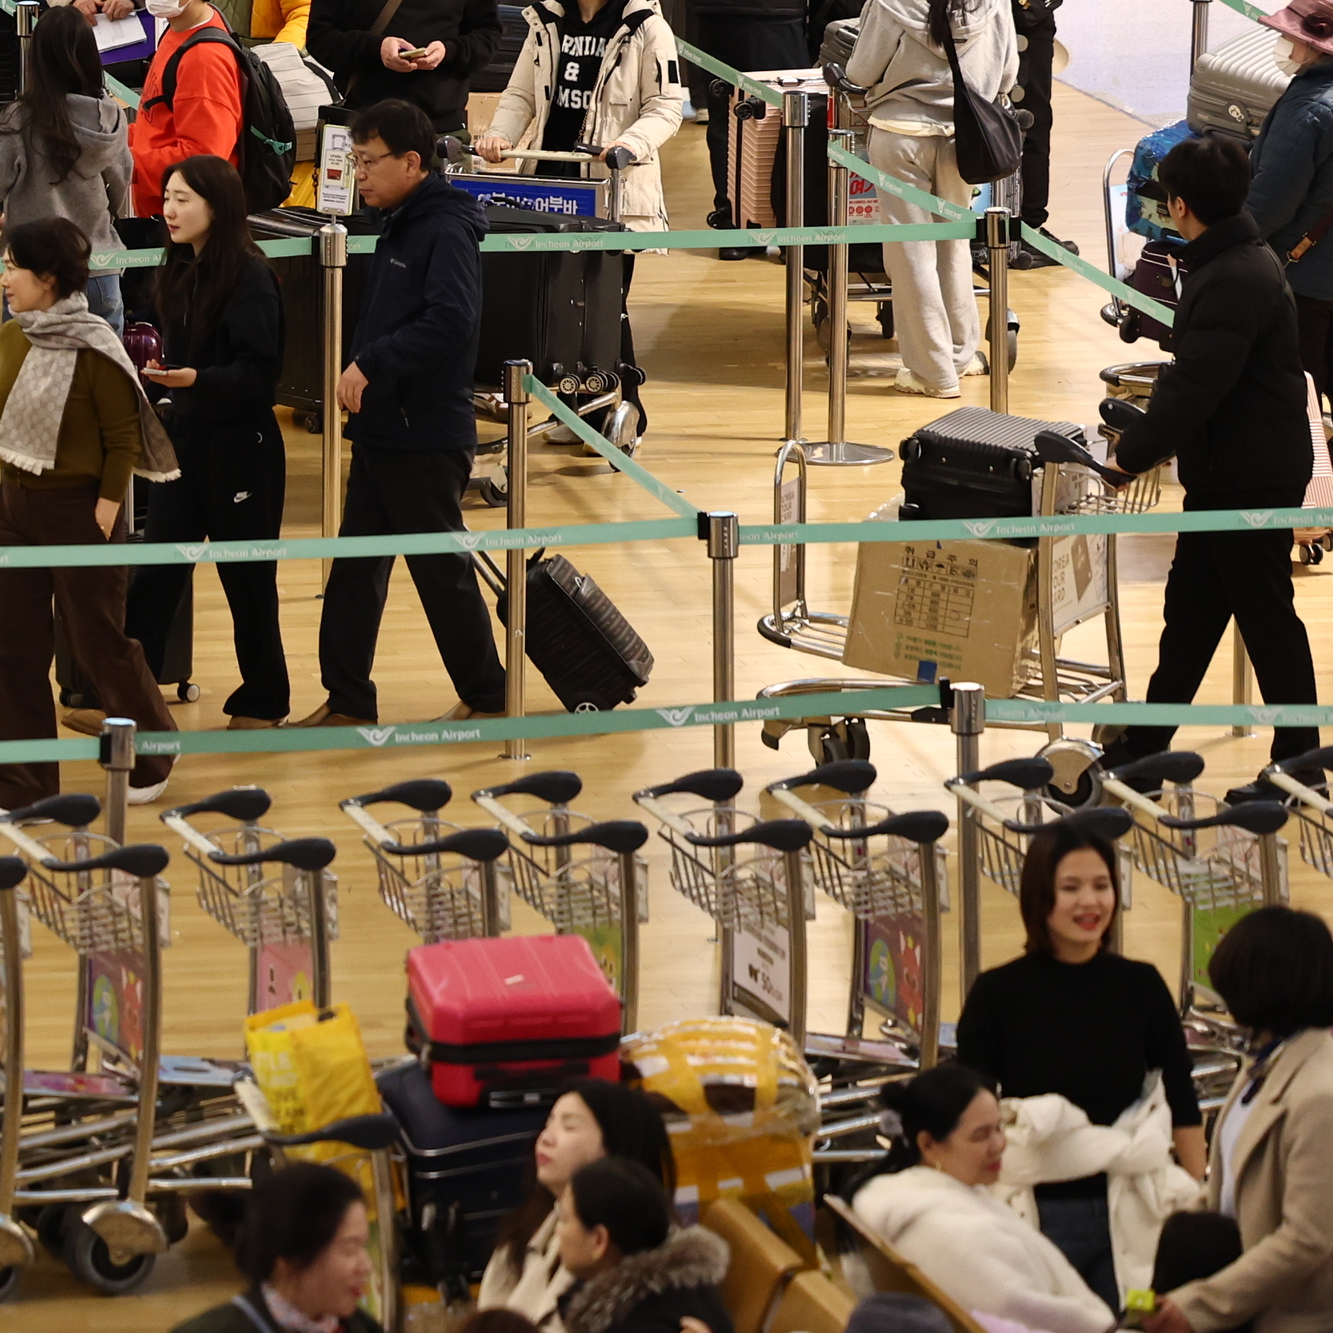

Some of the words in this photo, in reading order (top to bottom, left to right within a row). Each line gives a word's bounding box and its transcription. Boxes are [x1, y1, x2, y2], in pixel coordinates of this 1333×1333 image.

[564, 62, 580, 82] &
[534, 241, 569, 250] Incheon
[572, 238, 606, 250] Airport
[778, 235, 812, 246] Incheon
[814, 233, 845, 244] Airport
[116, 256, 150, 266] Incheon
[1273, 515, 1314, 528] Incheon
[764, 528, 800, 541] Airport
[995, 525, 1035, 536] Incheon
[1037, 522, 1076, 535] Airport
[485, 536, 526, 547] Incheon
[528, 533, 565, 547] Airport
[208, 548, 249, 559] Incheon
[251, 545, 288, 558] Airport
[694, 708, 736, 720] Incheon
[738, 705, 780, 718] Airport
[1023, 707, 1066, 720] Airport
[395, 732, 437, 743] Incheon
[439, 728, 480, 742] Airport
[142, 740, 182, 752] Airport
